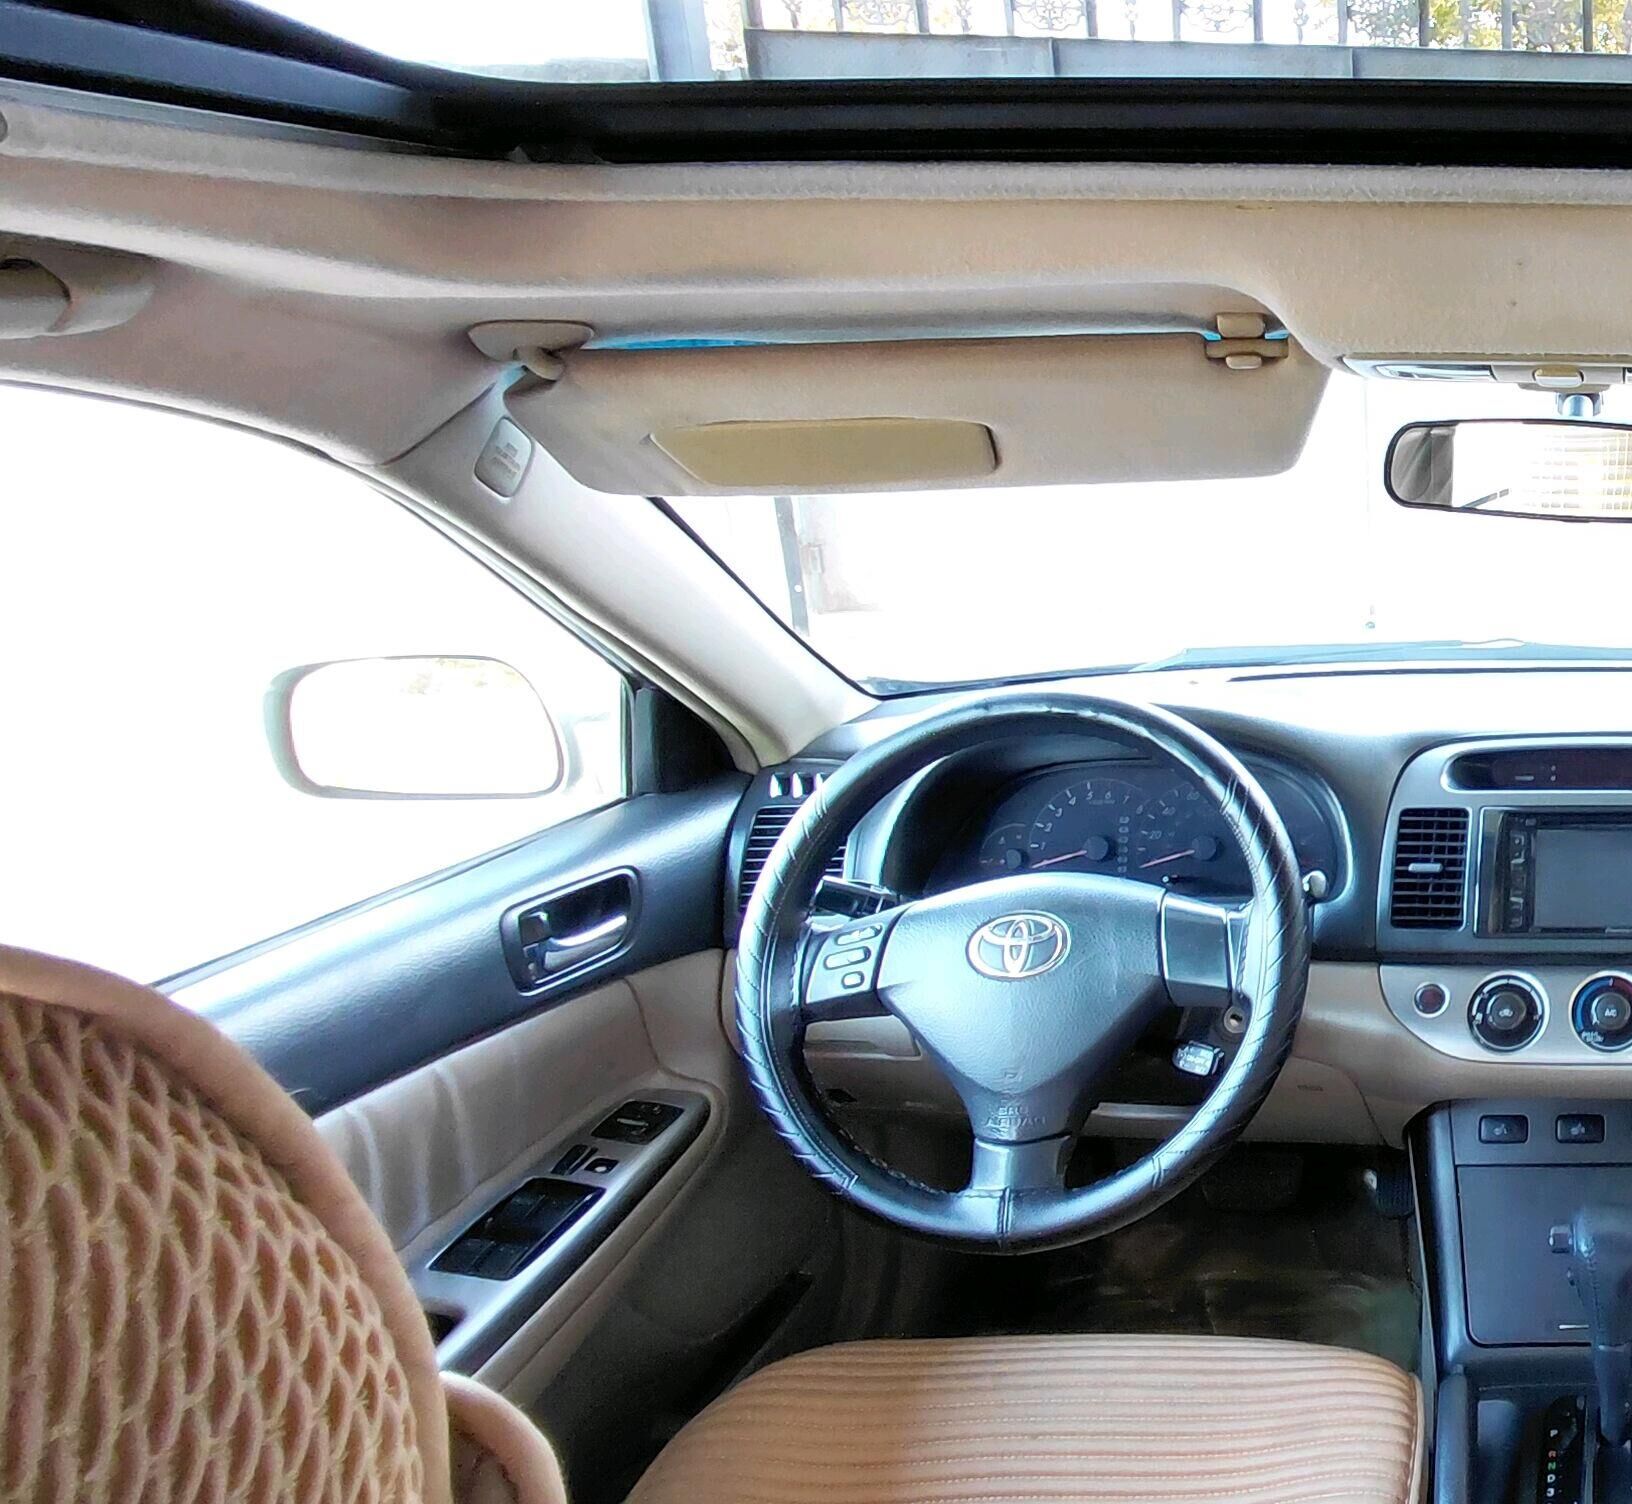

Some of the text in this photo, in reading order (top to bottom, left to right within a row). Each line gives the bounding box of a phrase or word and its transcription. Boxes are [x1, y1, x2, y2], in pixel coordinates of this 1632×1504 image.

[1086, 791, 1094, 800] 5
[1105, 790, 1112, 800] 6
[1068, 796, 1077, 806] 4
[1054, 808, 1063, 818] 3
[1043, 822, 1053, 832] 2
[1149, 830, 1162, 840] 20
[1550, 1429, 1558, 1437] P
[1547, 1461, 1556, 1470] N
[1547, 1474, 1556, 1483] D
